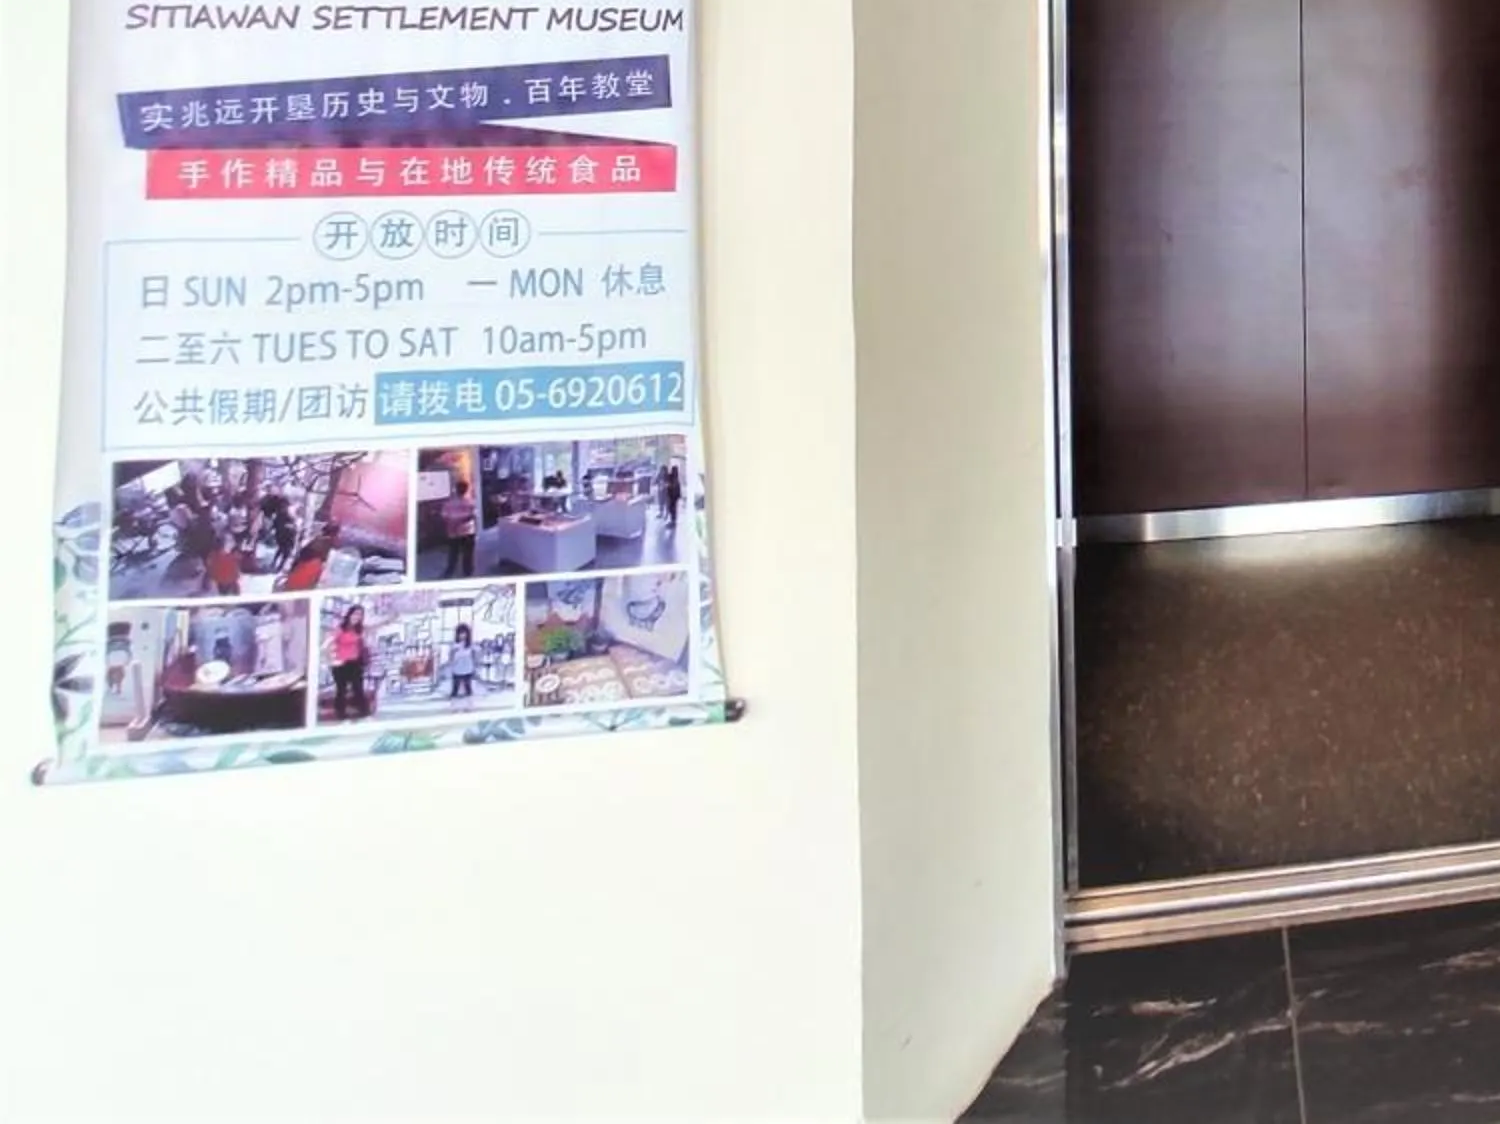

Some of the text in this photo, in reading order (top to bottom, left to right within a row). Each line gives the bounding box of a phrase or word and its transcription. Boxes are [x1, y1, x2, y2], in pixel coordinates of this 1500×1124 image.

[124, 3, 684, 33] SITIAWAN SETTLEMENT MUSEUM
[177, 154, 643, 191] 手作精品与在地传统食品
[323, 215, 521, 251] 开放时间
[141, 273, 425, 313] 日 SUN 2pm-5pm
[509, 267, 584, 299] MON
[600, 262, 667, 300] 休息
[134, 320, 648, 368] 二至六 TUES TO SAT 10am-5pm
[133, 371, 683, 427] 公共假期/团访 请拨电 05-6920612
